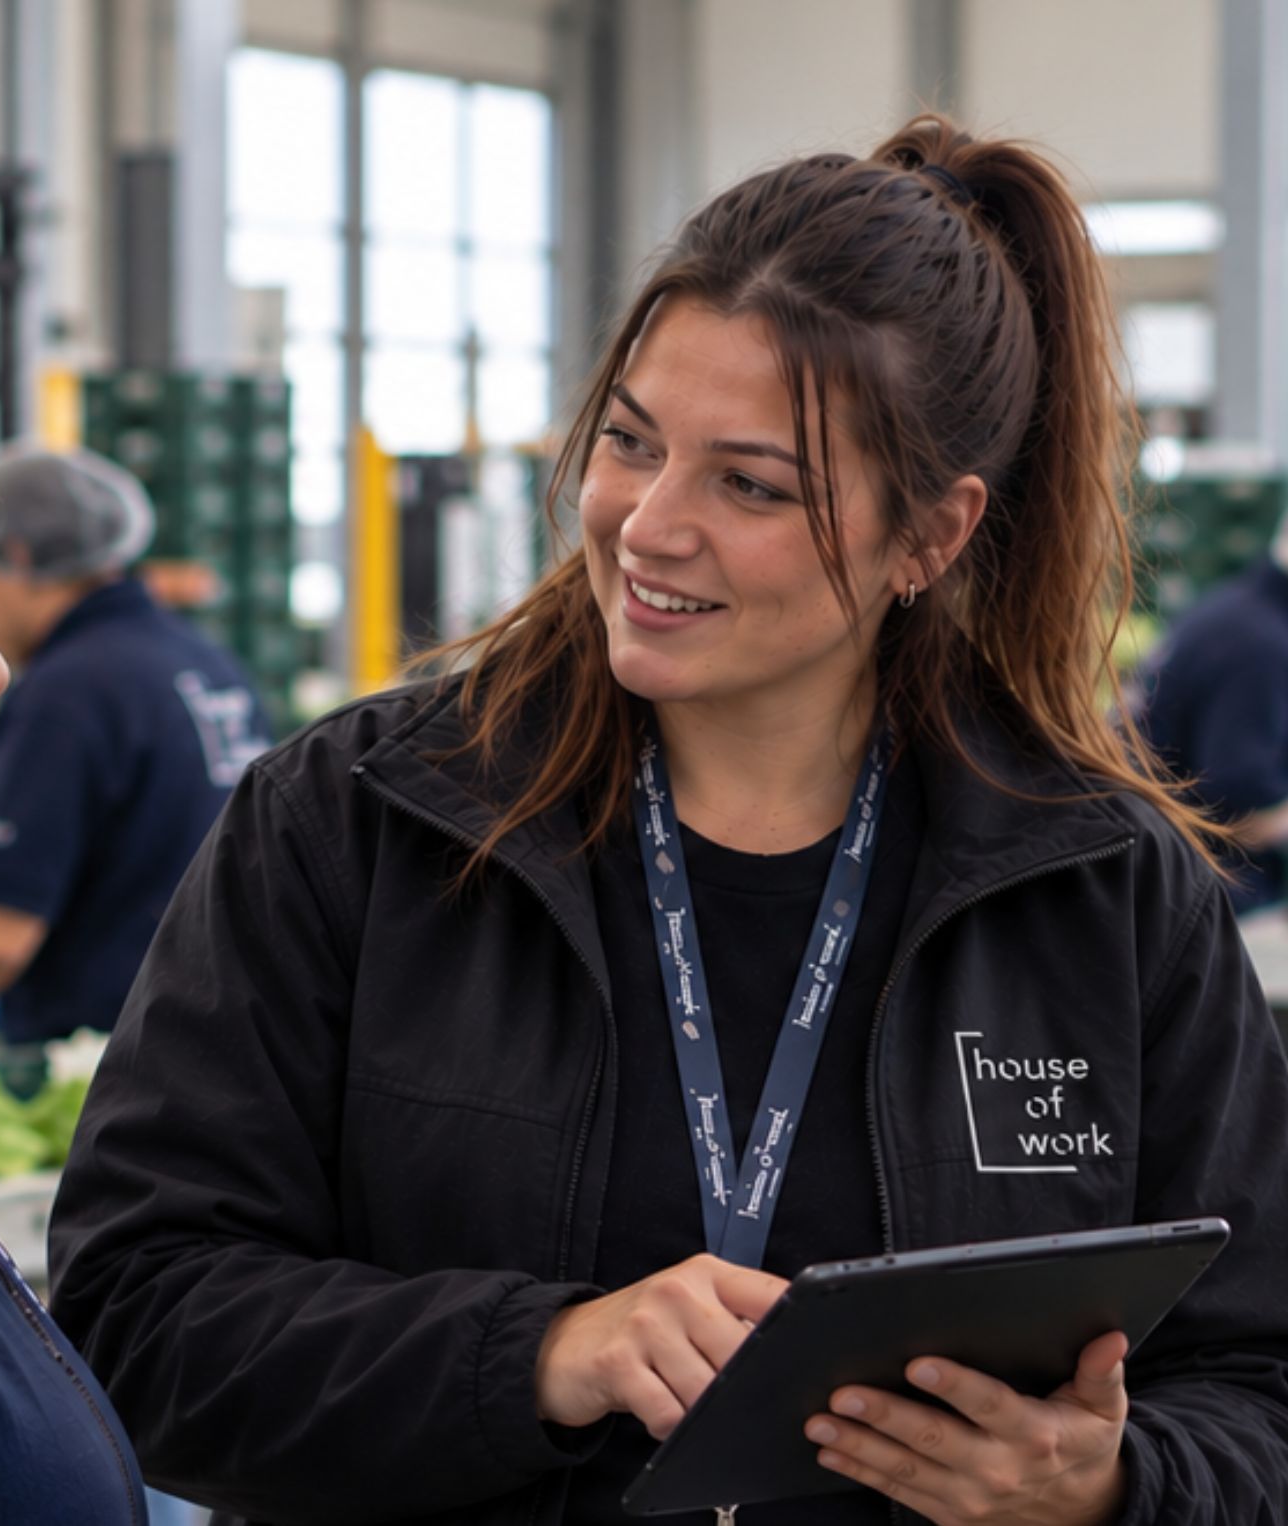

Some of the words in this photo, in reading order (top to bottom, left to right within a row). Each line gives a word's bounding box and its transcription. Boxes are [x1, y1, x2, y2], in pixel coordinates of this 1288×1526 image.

[973, 1047, 1089, 1081] house
[1025, 1085, 1064, 1119] of
[1017, 1122, 1114, 1156] work
